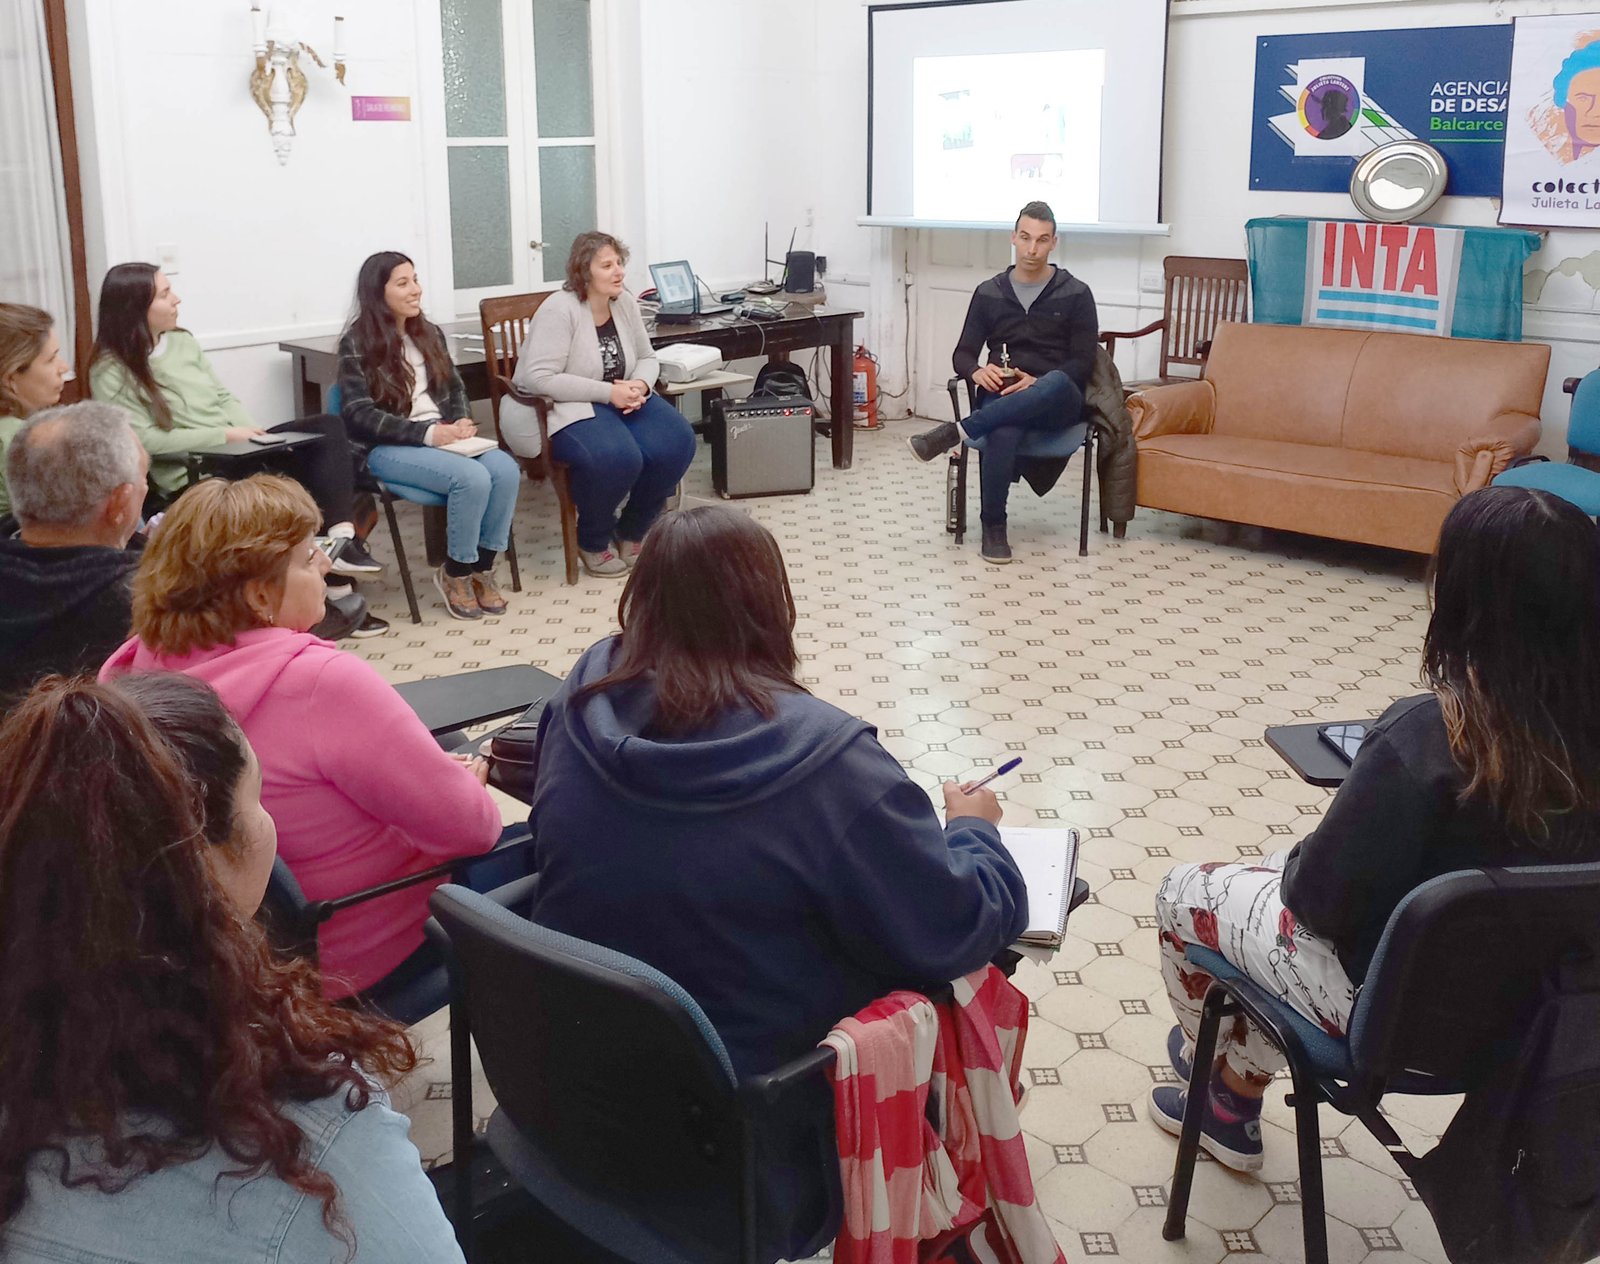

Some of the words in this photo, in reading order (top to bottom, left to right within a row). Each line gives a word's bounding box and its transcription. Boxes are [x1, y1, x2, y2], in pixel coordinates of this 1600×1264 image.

[1430, 98, 1457, 113] DE
[1430, 116, 1504, 131] Balcarce
[1531, 196, 1579, 209] Julieta
[1322, 222, 1438, 296] INTA
